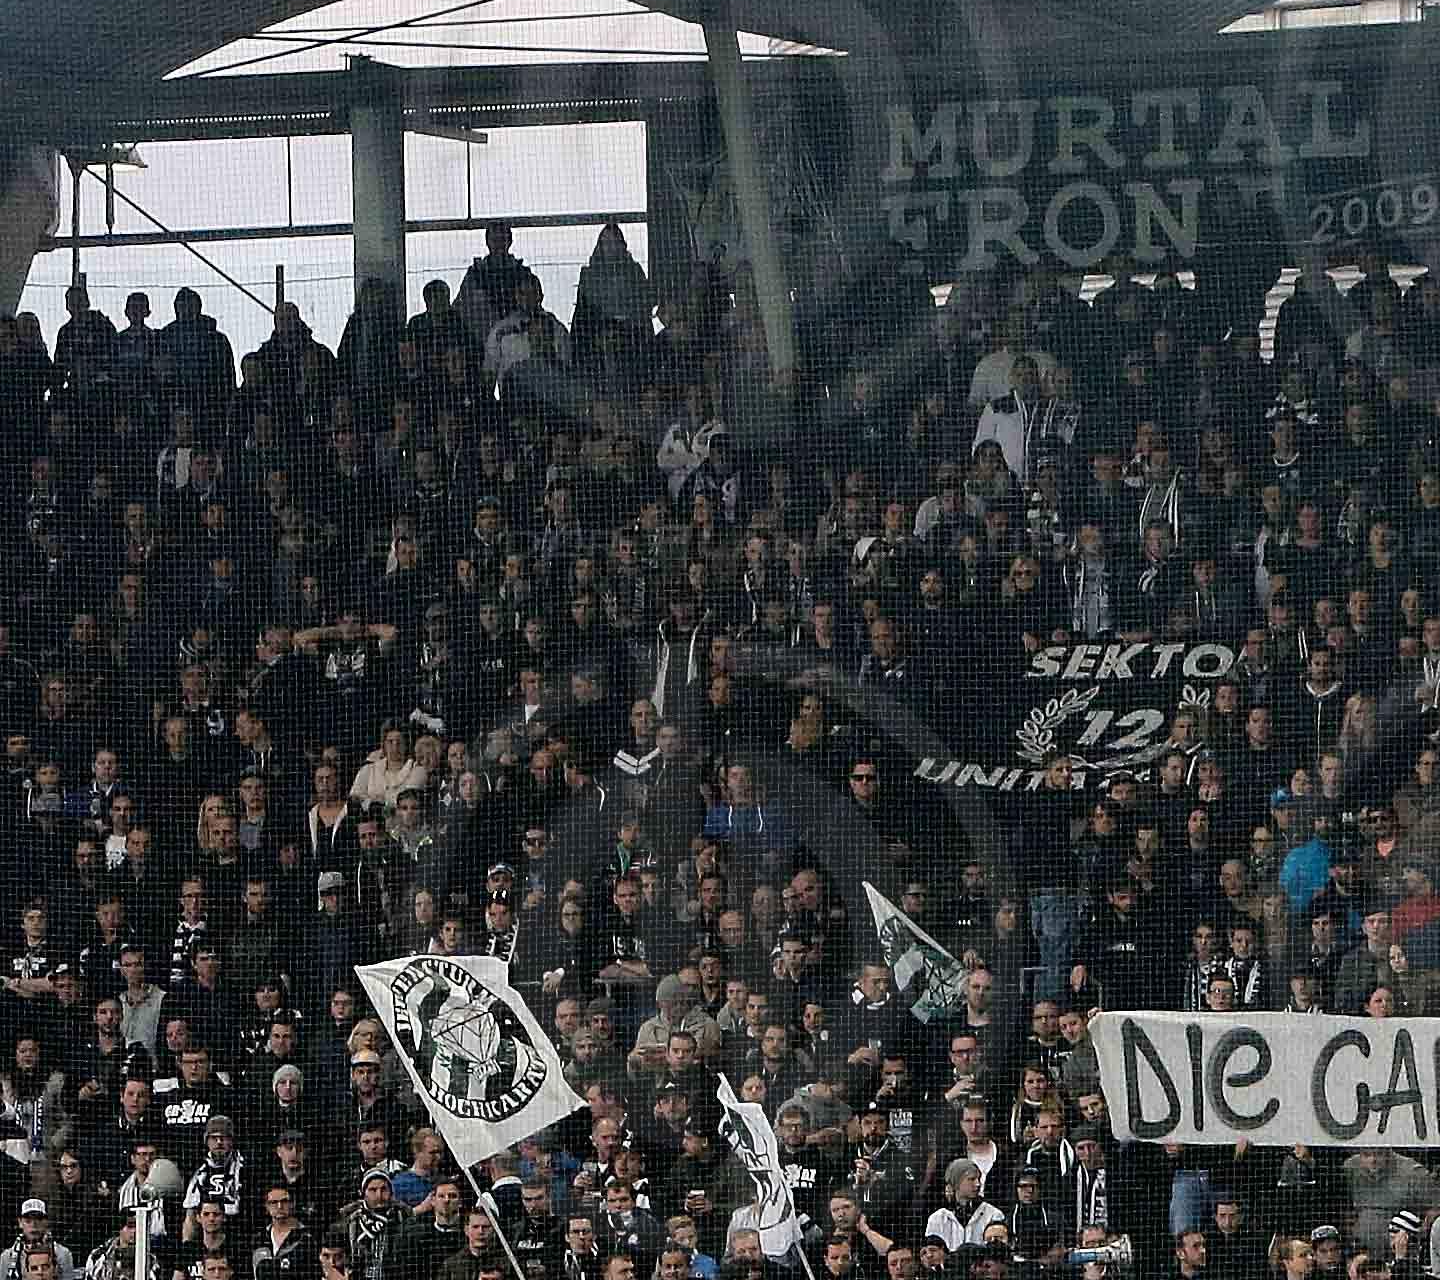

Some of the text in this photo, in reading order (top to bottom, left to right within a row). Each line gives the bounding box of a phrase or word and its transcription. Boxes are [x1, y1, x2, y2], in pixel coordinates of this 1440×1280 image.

[882, 81, 1373, 184] MURTAL
[1307, 183, 1440, 244] 2009
[1025, 642, 1252, 680] SEKTO
